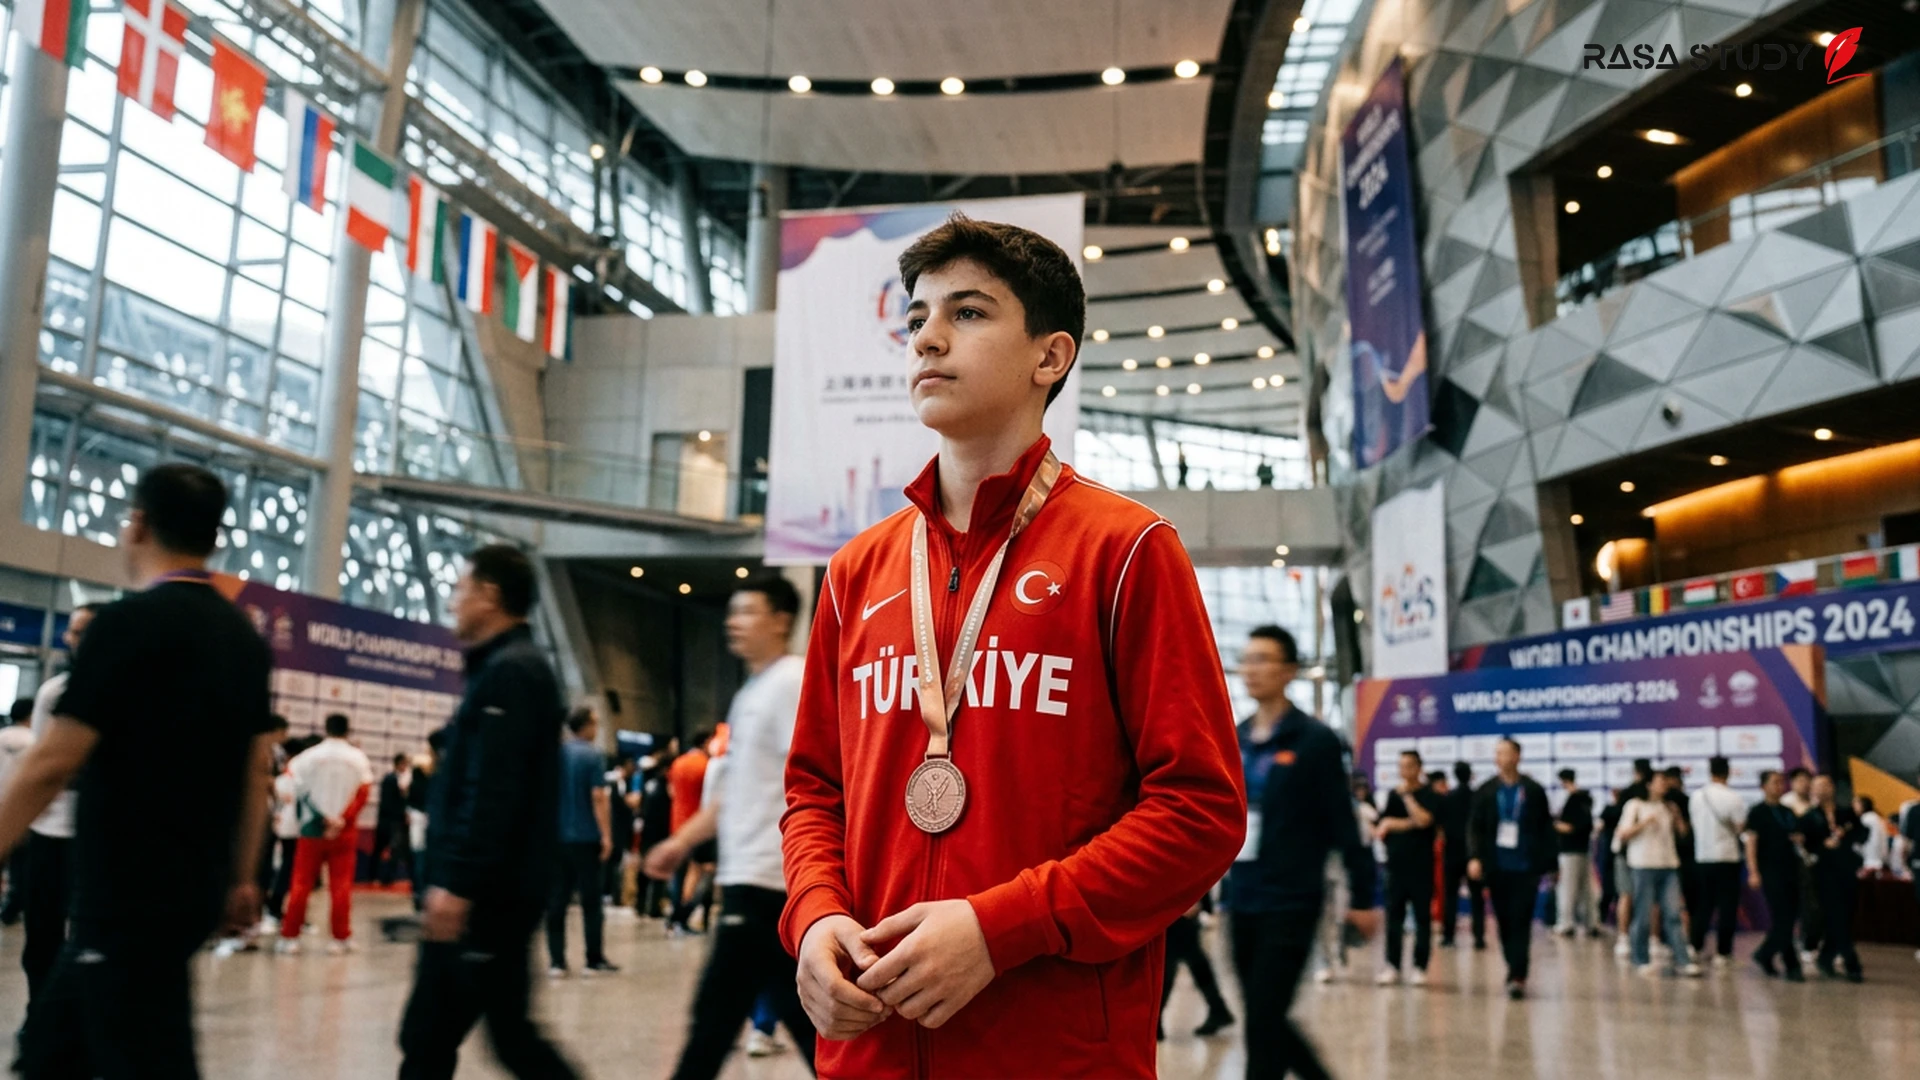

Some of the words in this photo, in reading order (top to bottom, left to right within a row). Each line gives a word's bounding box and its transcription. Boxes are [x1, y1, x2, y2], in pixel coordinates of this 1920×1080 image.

[1586, 606, 1817, 665] CHAMPIONSHIPS
[1822, 595, 1915, 642] 2024
[1452, 690, 1504, 713] WORLD
[1636, 678, 1679, 704] 2024
